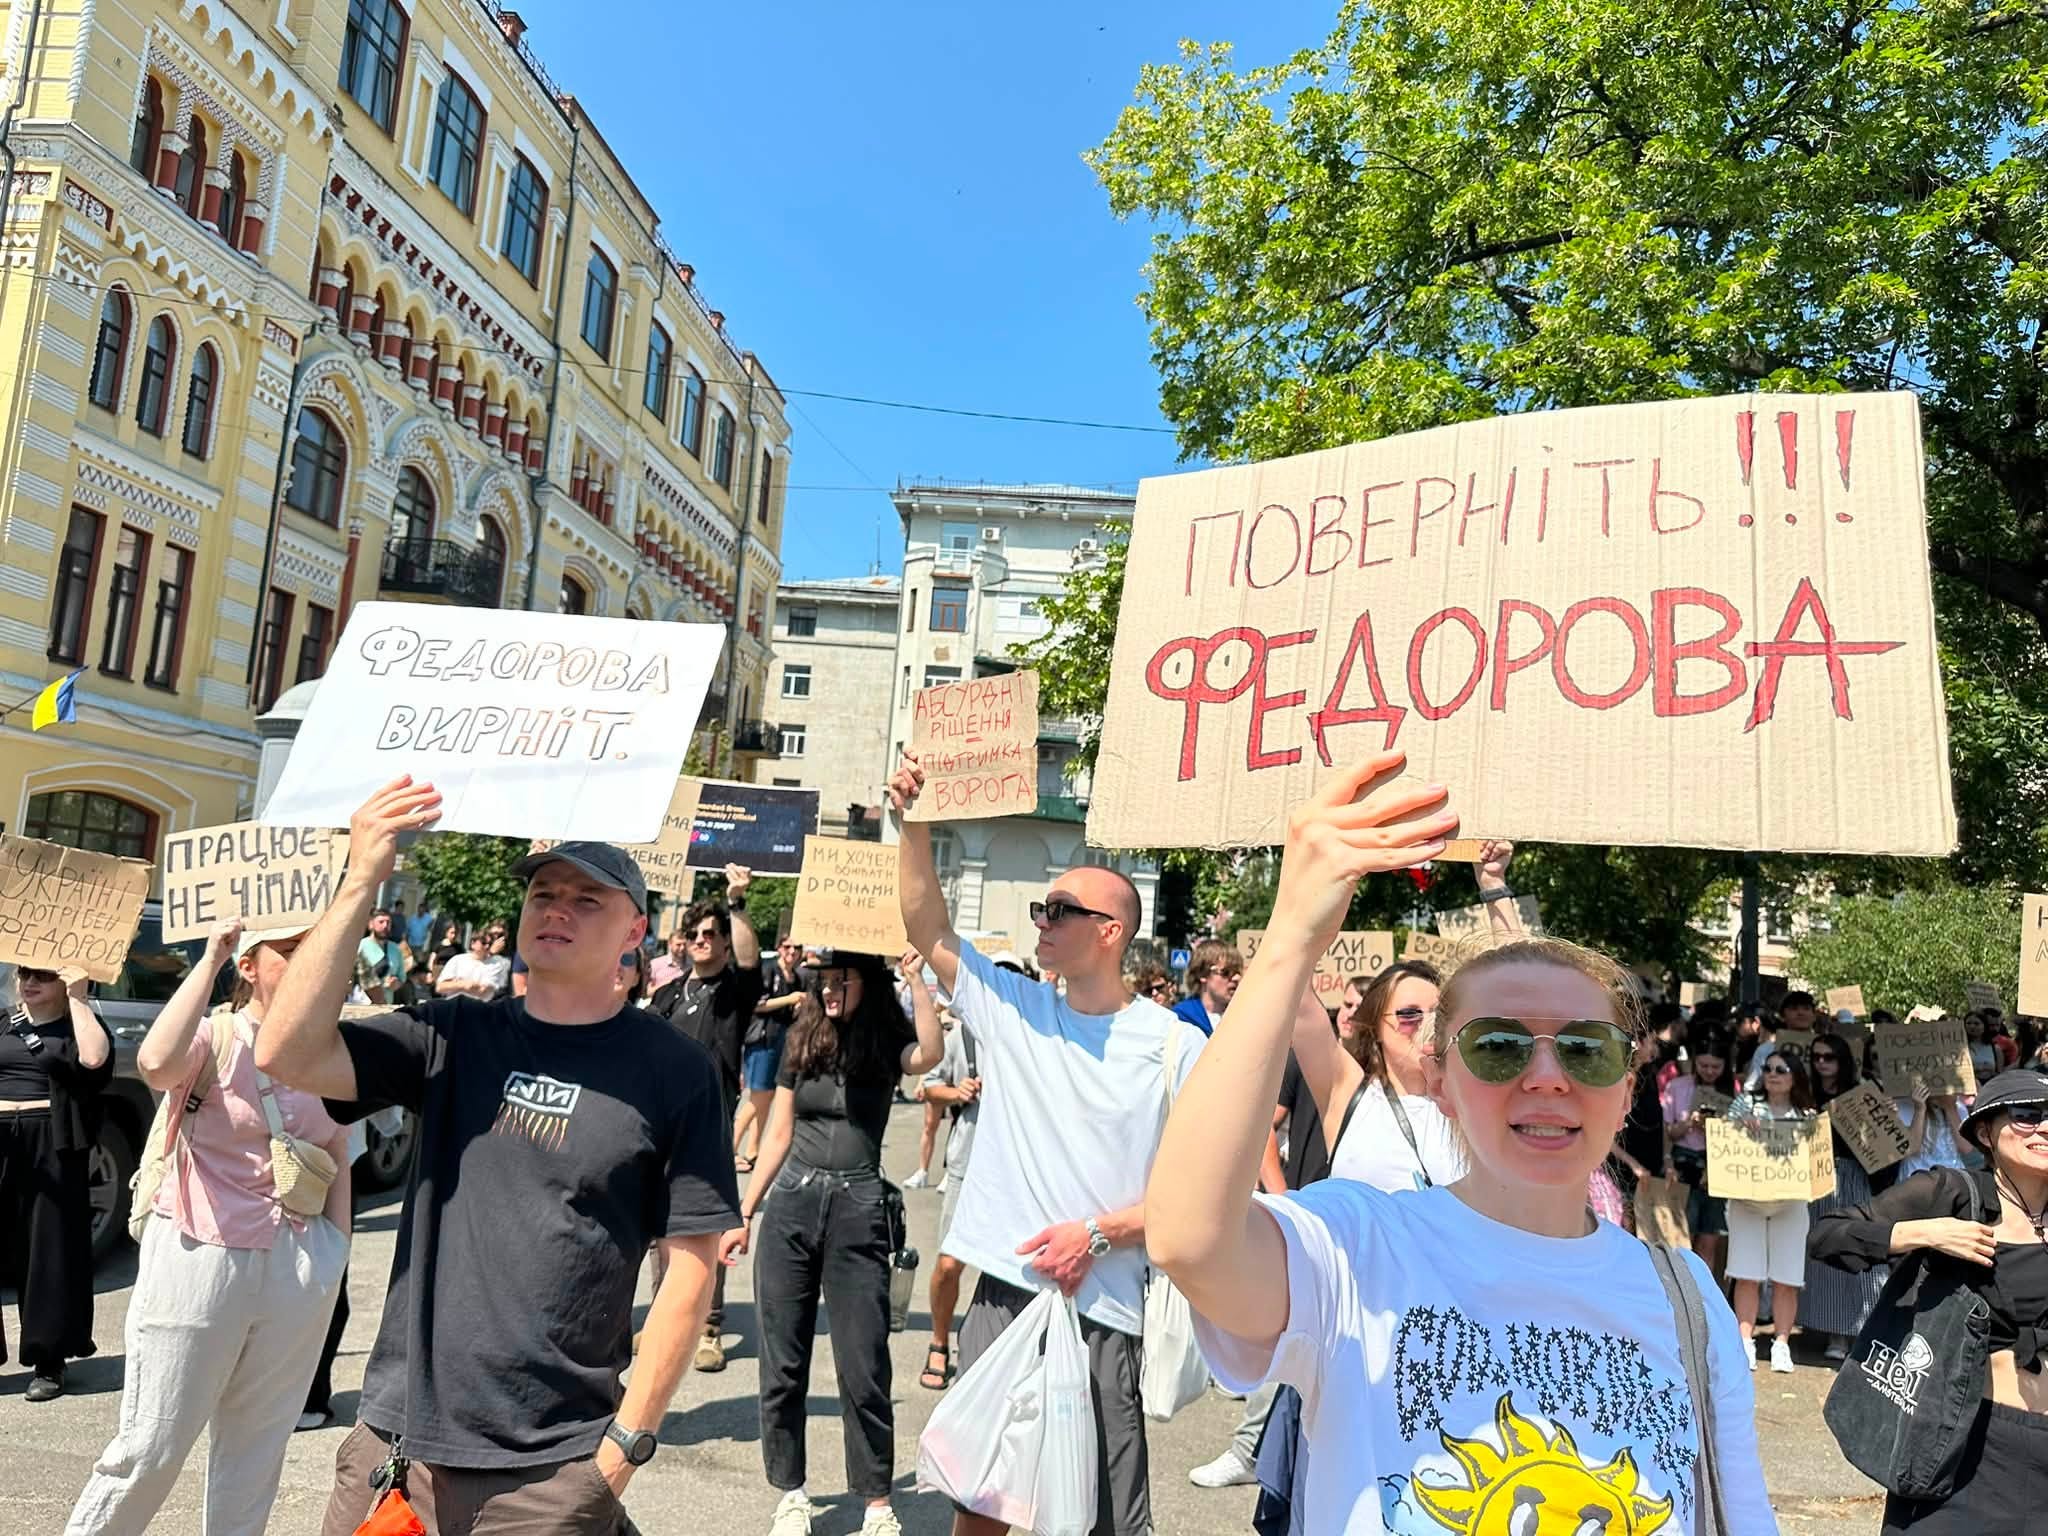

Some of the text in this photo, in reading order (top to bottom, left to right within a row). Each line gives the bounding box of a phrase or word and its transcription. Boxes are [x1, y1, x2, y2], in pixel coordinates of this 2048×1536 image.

[360, 626, 671, 695] ФЕДОРОВА
[1145, 576, 1907, 782] ФЕДОРОВА
[915, 672, 1024, 720] АБСУРДНІ
[931, 709, 1012, 742] РІШЕННЯ
[922, 739, 1022, 772] ПІДТРИМКА
[935, 773, 1031, 812] ВОРОГА
[813, 847, 839, 864] МИ
[0, 848, 131, 911] УКРАЇНІ
[168, 881, 217, 929] НЕ
[857, 896, 877, 909] НЕ
[1334, 954, 1383, 973] ТОГО
